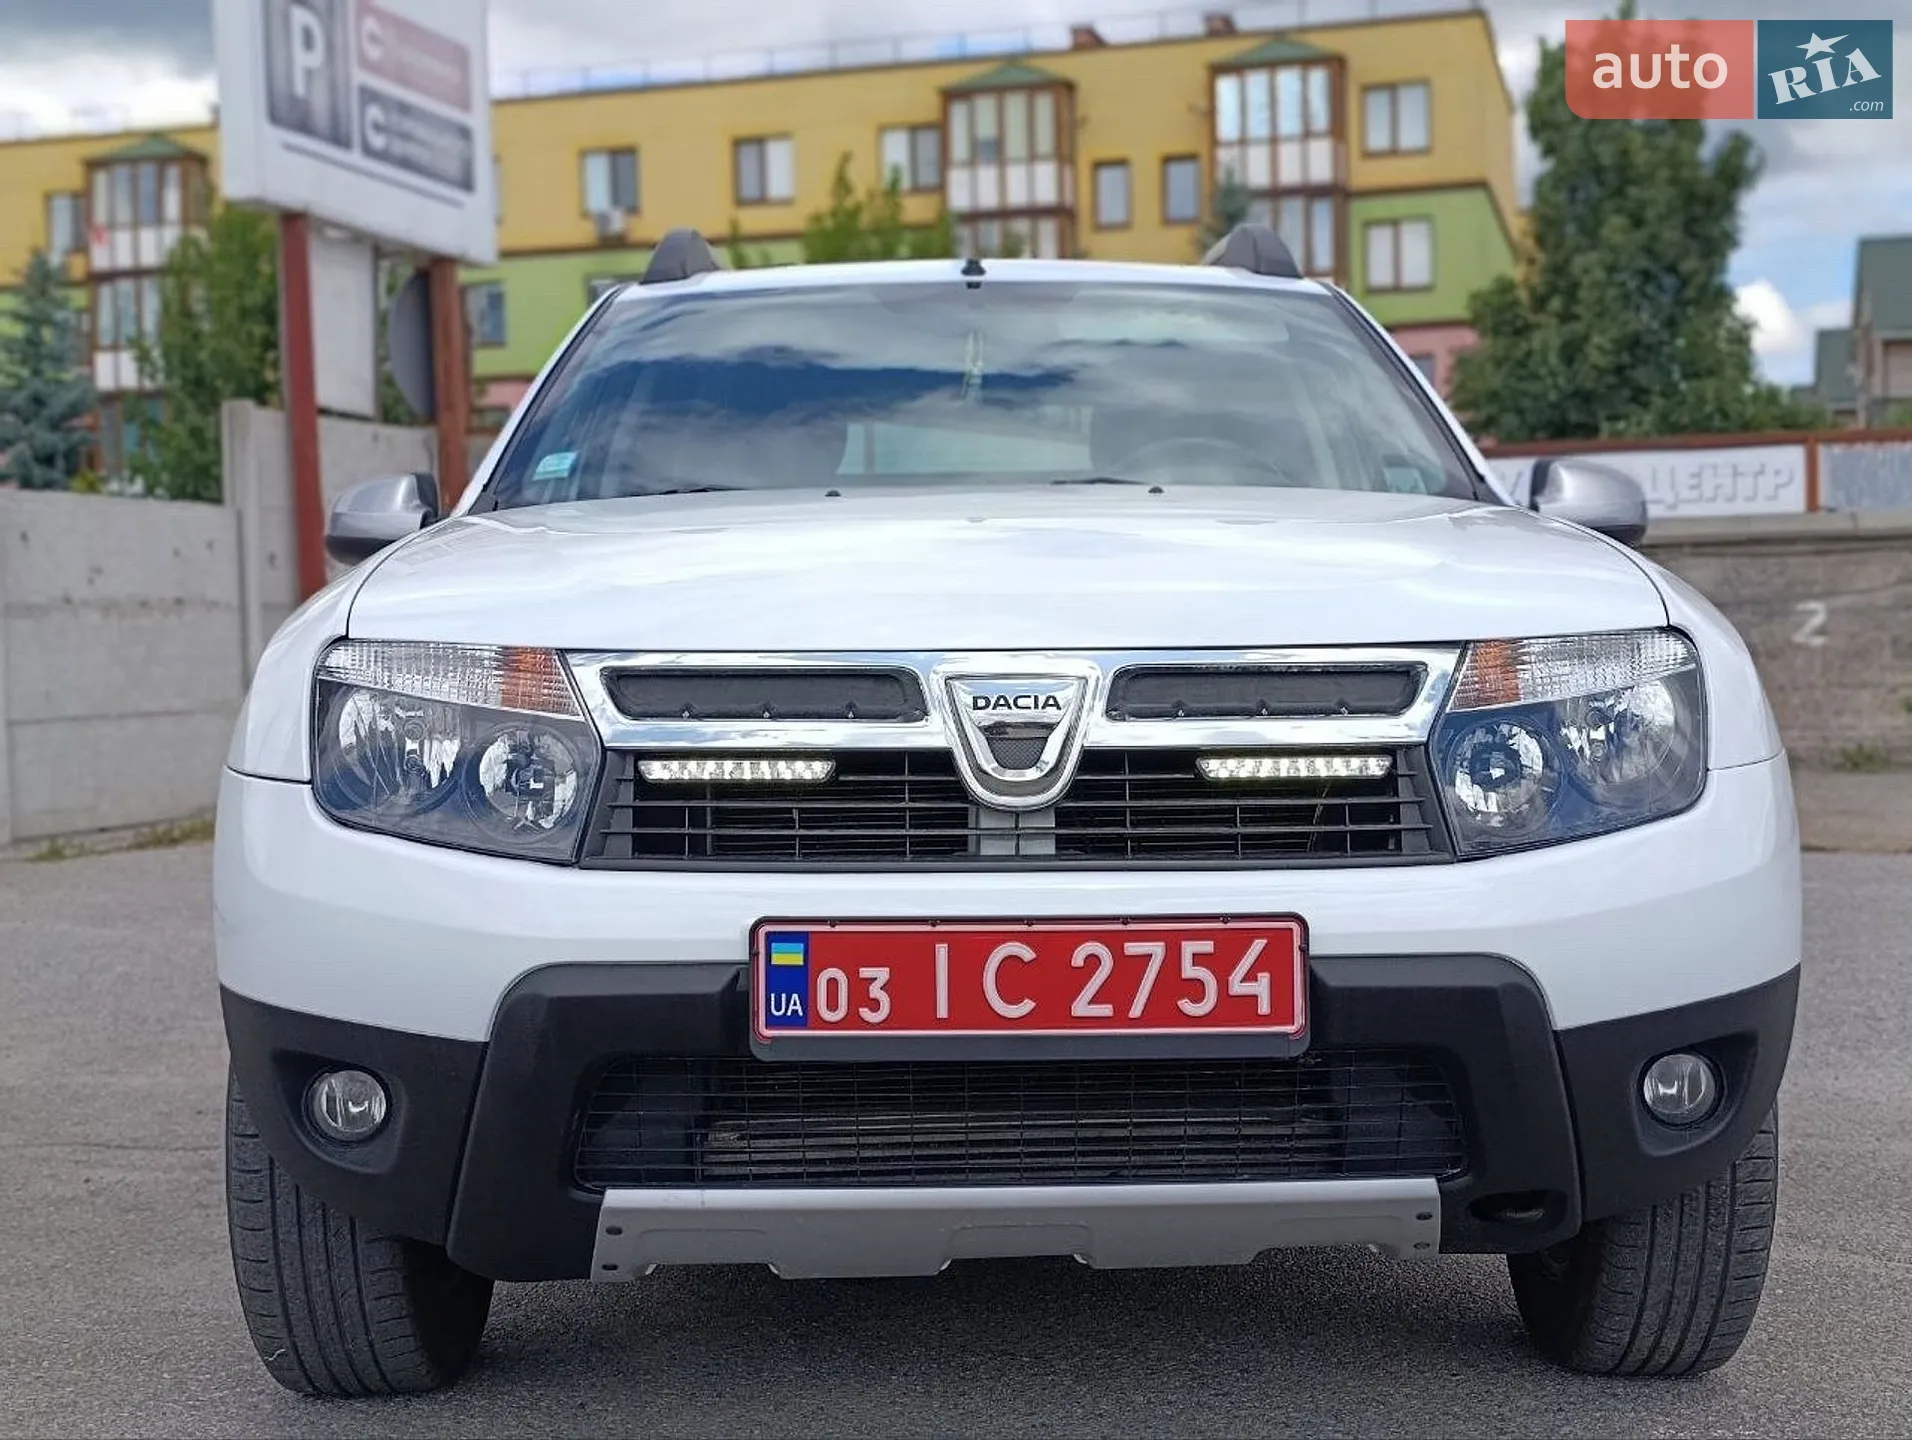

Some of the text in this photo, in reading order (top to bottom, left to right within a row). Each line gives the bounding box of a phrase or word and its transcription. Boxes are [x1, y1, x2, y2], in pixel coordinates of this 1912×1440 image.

[289, 4, 326, 99] P
[1643, 460, 1796, 510] ЦЕНТР
[972, 694, 1062, 711] DACIA
[770, 992, 804, 1017] UA
[816, 966, 892, 1024] 03
[1070, 938, 1272, 1018] 2754
